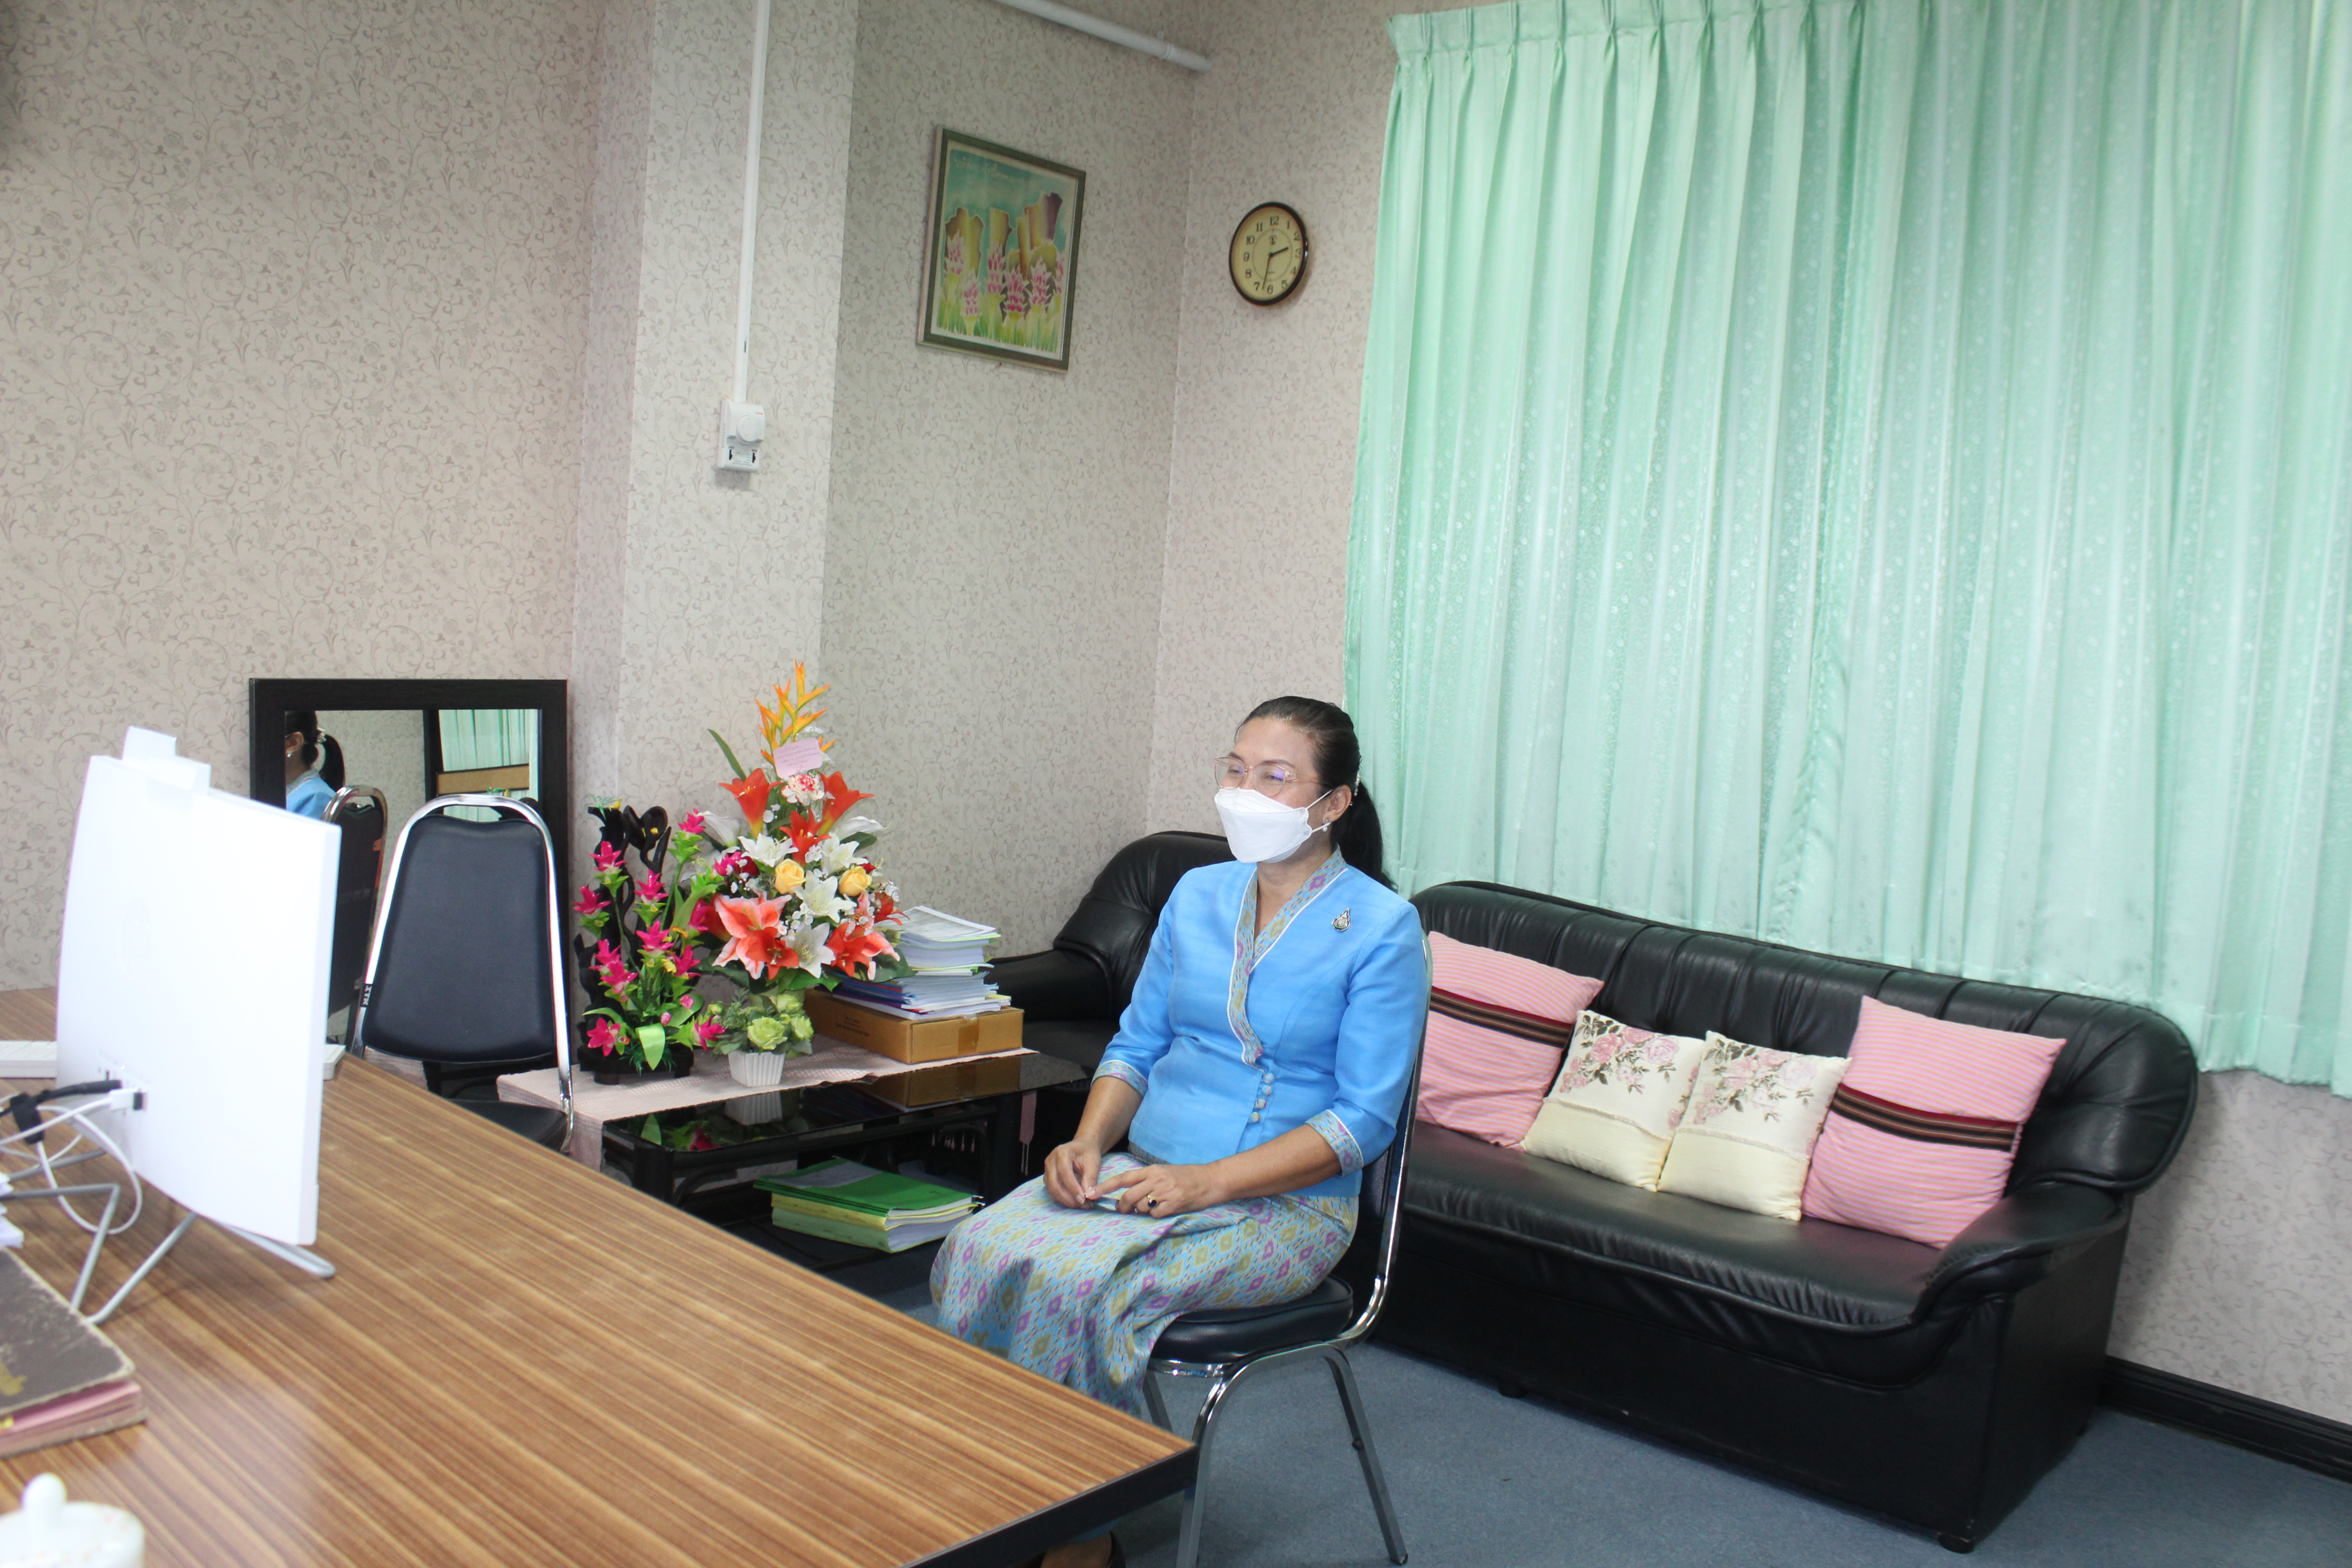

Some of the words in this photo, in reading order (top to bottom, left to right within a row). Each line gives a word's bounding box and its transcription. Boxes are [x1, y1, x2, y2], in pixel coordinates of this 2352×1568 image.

[1270, 216, 1279, 225] 12
[1286, 220, 1290, 229] 1
[1256, 222, 1263, 232] 11
[1246, 235, 1254, 245] 10
[1294, 232, 1300, 241] 2
[1243, 252, 1250, 262] 9
[1295, 248, 1301, 258] 3
[1245, 268, 1251, 278] 8
[1290, 266, 1296, 275] 4
[1254, 281, 1260, 291] 7
[1267, 284, 1273, 294] 6
[1281, 279, 1288, 289] 5
[363, 985, 372, 1005] ITK
